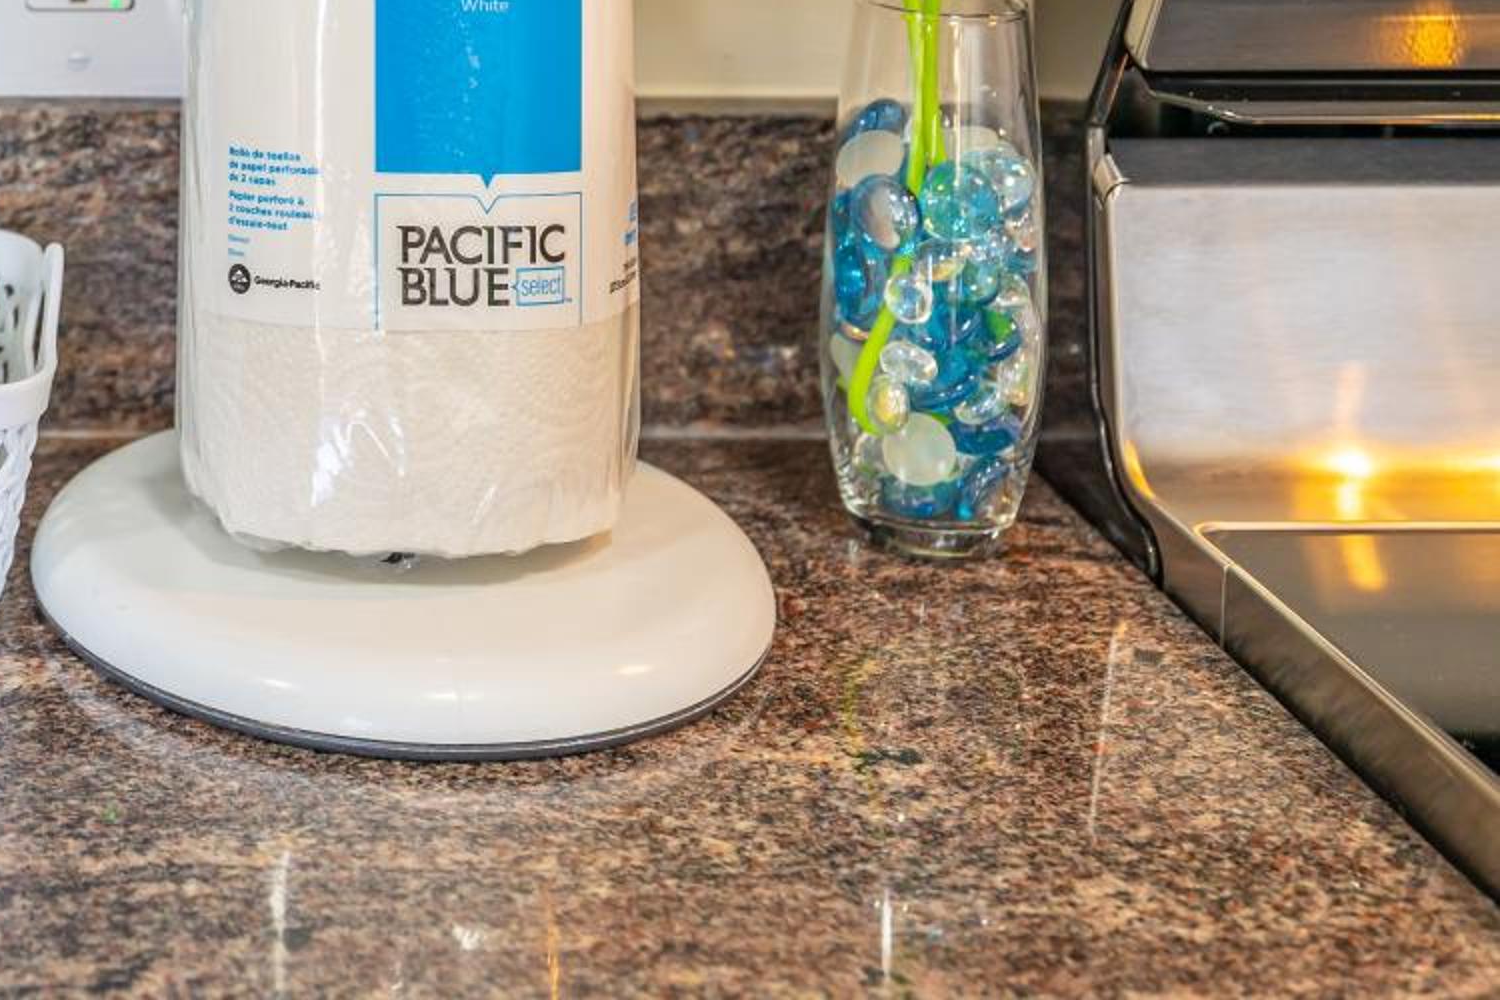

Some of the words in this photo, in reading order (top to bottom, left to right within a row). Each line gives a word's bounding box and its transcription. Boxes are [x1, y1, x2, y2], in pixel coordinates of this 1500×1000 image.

[397, 225, 566, 264] PACIFIC
[397, 267, 510, 306] BLUE
[521, 274, 562, 297] select
